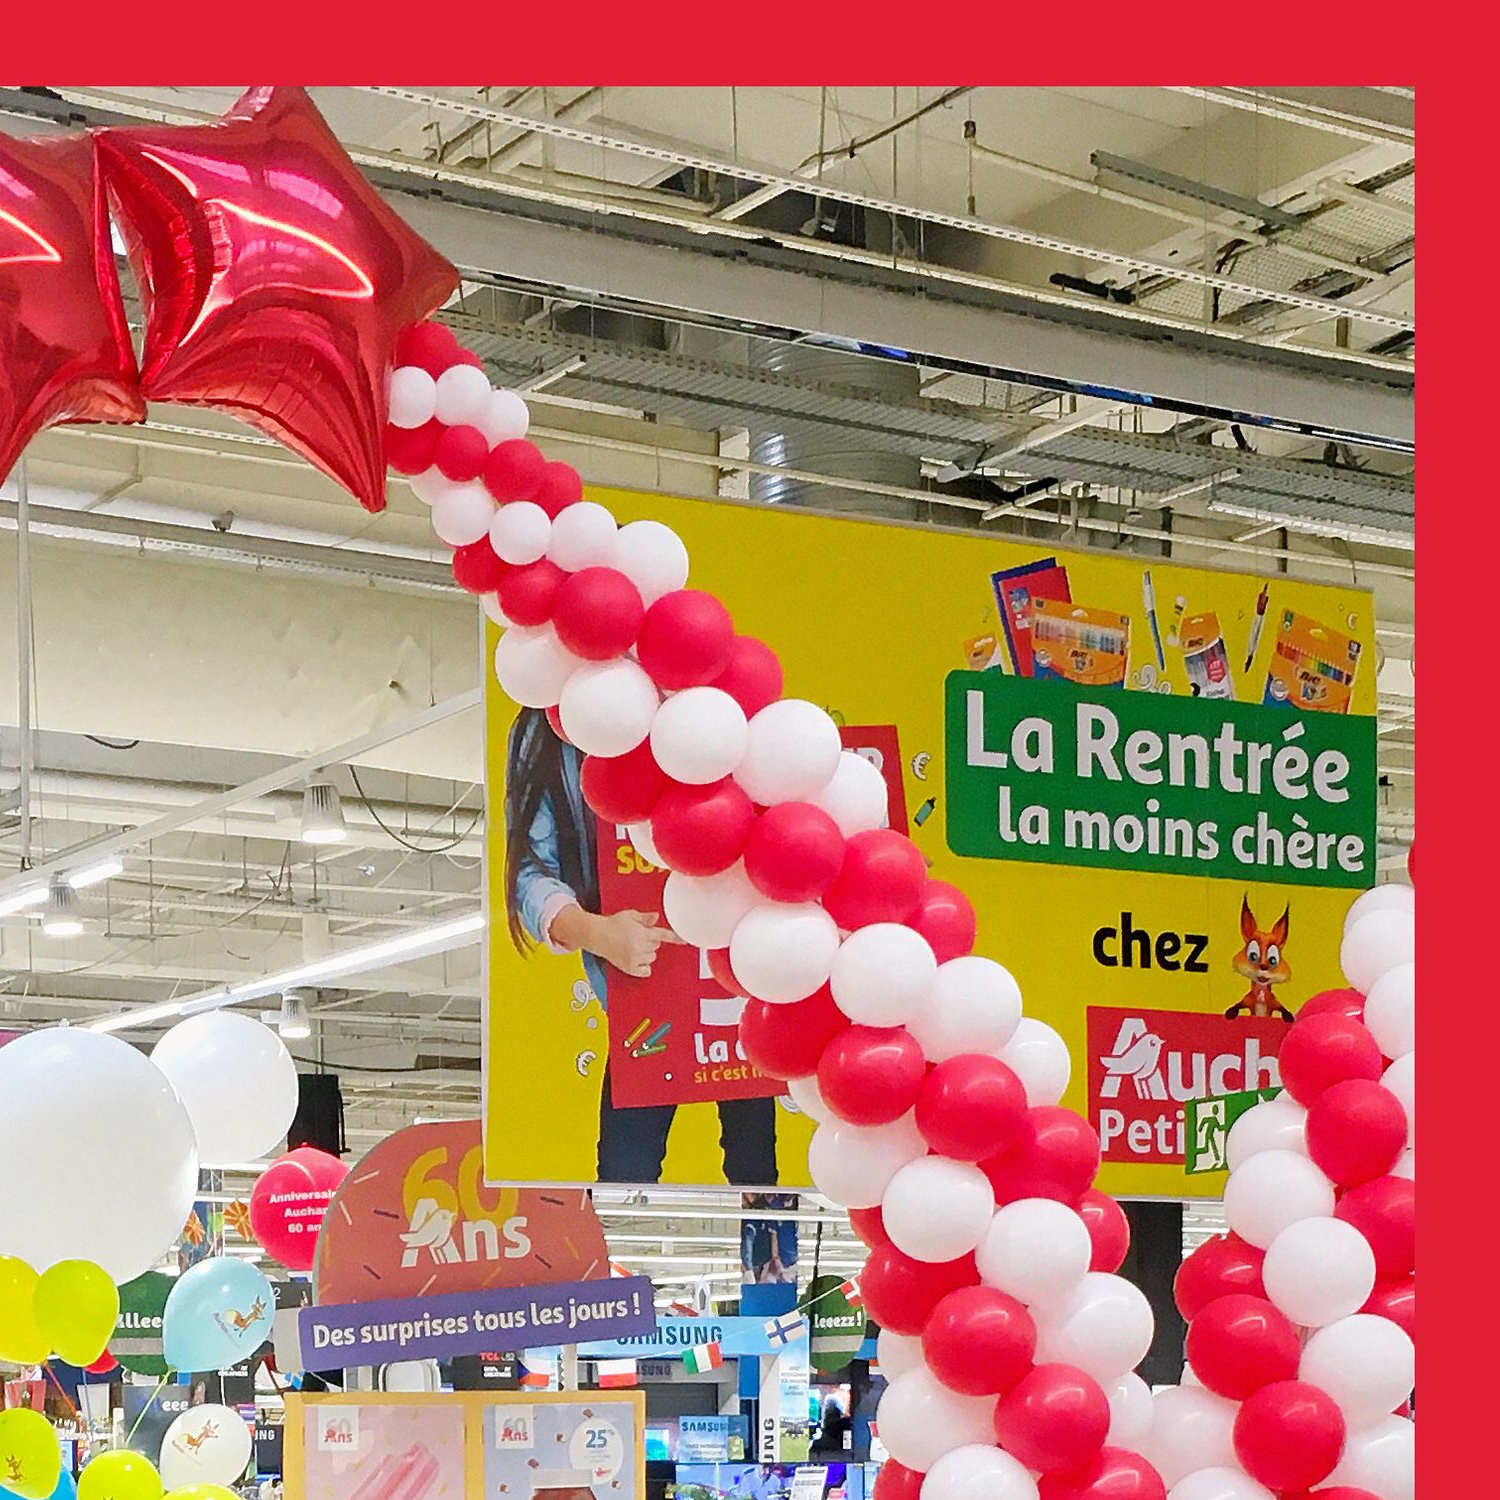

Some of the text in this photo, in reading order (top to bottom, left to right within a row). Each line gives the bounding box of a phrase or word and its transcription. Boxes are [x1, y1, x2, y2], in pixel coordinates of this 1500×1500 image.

[967, 690, 1349, 803] La Rentrée
[999, 787, 1365, 872] la moins chère
[1093, 912, 1208, 973] chez
[694, 1033, 728, 1064] la
[694, 1065, 748, 1084] si c'est
[1100, 1018, 1283, 1101] Auch
[1100, 1109, 1186, 1154] Peti
[288, 1224, 322, 1233] 60 an
[400, 1198, 532, 1268] Ans
[313, 1292, 641, 1349] Des surprises tous les jours !
[479, 1352, 499, 1361] TCL
